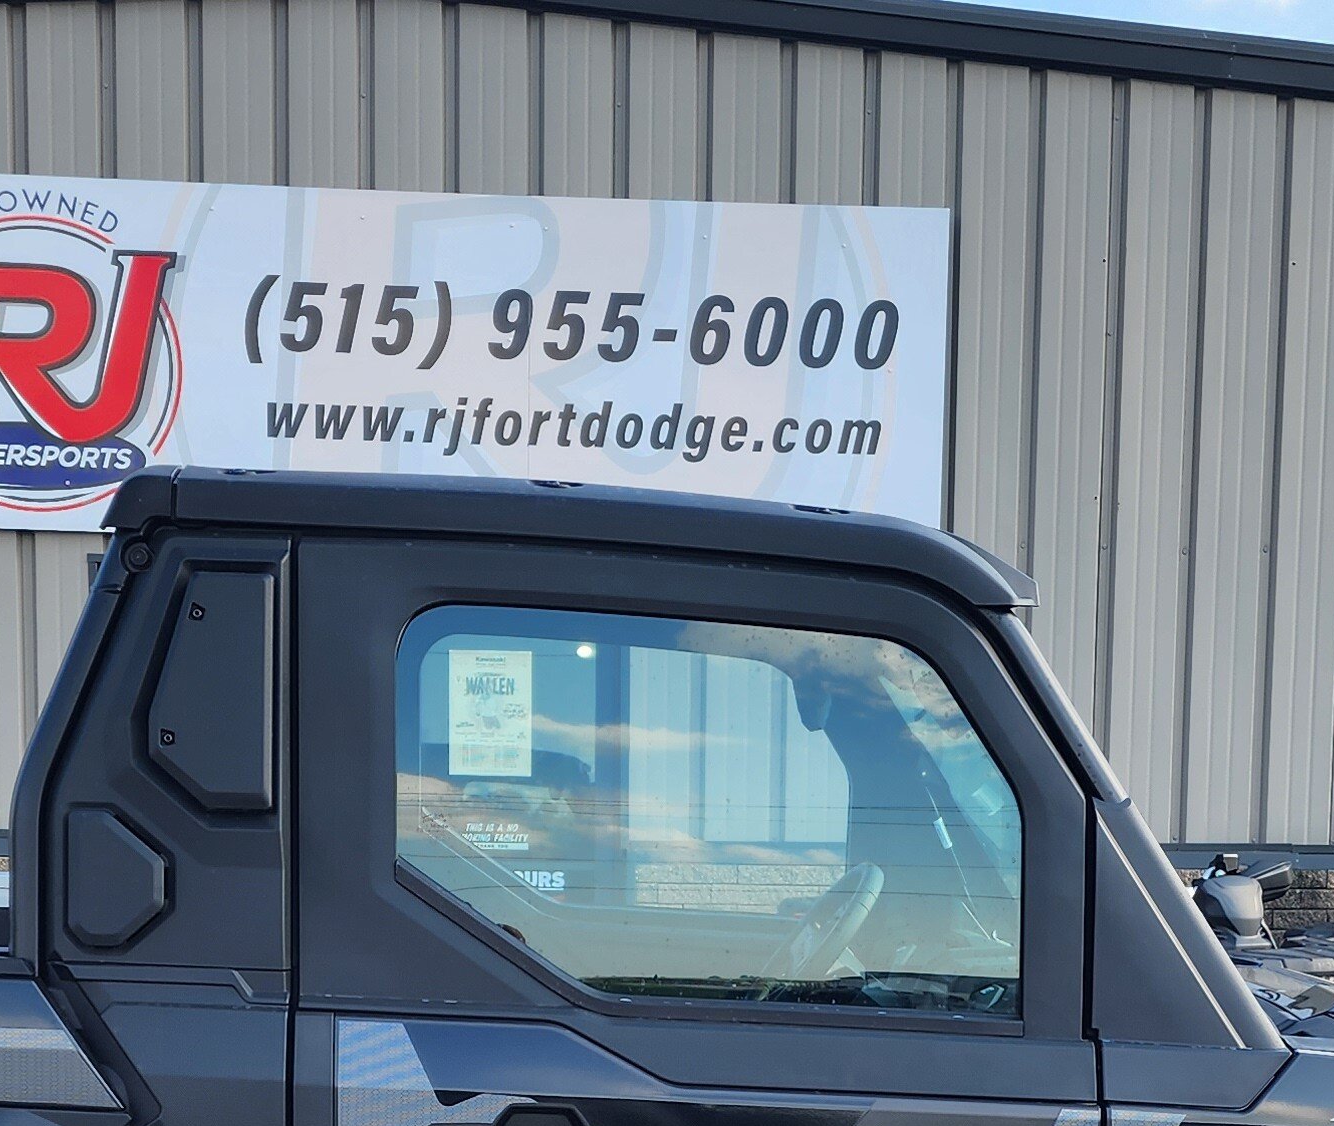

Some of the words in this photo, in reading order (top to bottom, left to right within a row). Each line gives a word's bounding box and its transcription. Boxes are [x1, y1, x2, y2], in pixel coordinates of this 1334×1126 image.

[245, 274, 454, 370] (515)
[486, 288, 901, 371] 955-6000
[266, 396, 883, 462] www.rjfortdodge.com
[466, 823, 484, 832] THIS
[486, 823, 495, 832] IS
[496, 823, 504, 832] A
[507, 823, 519, 832] NO
[493, 833, 529, 843] FACILITY
